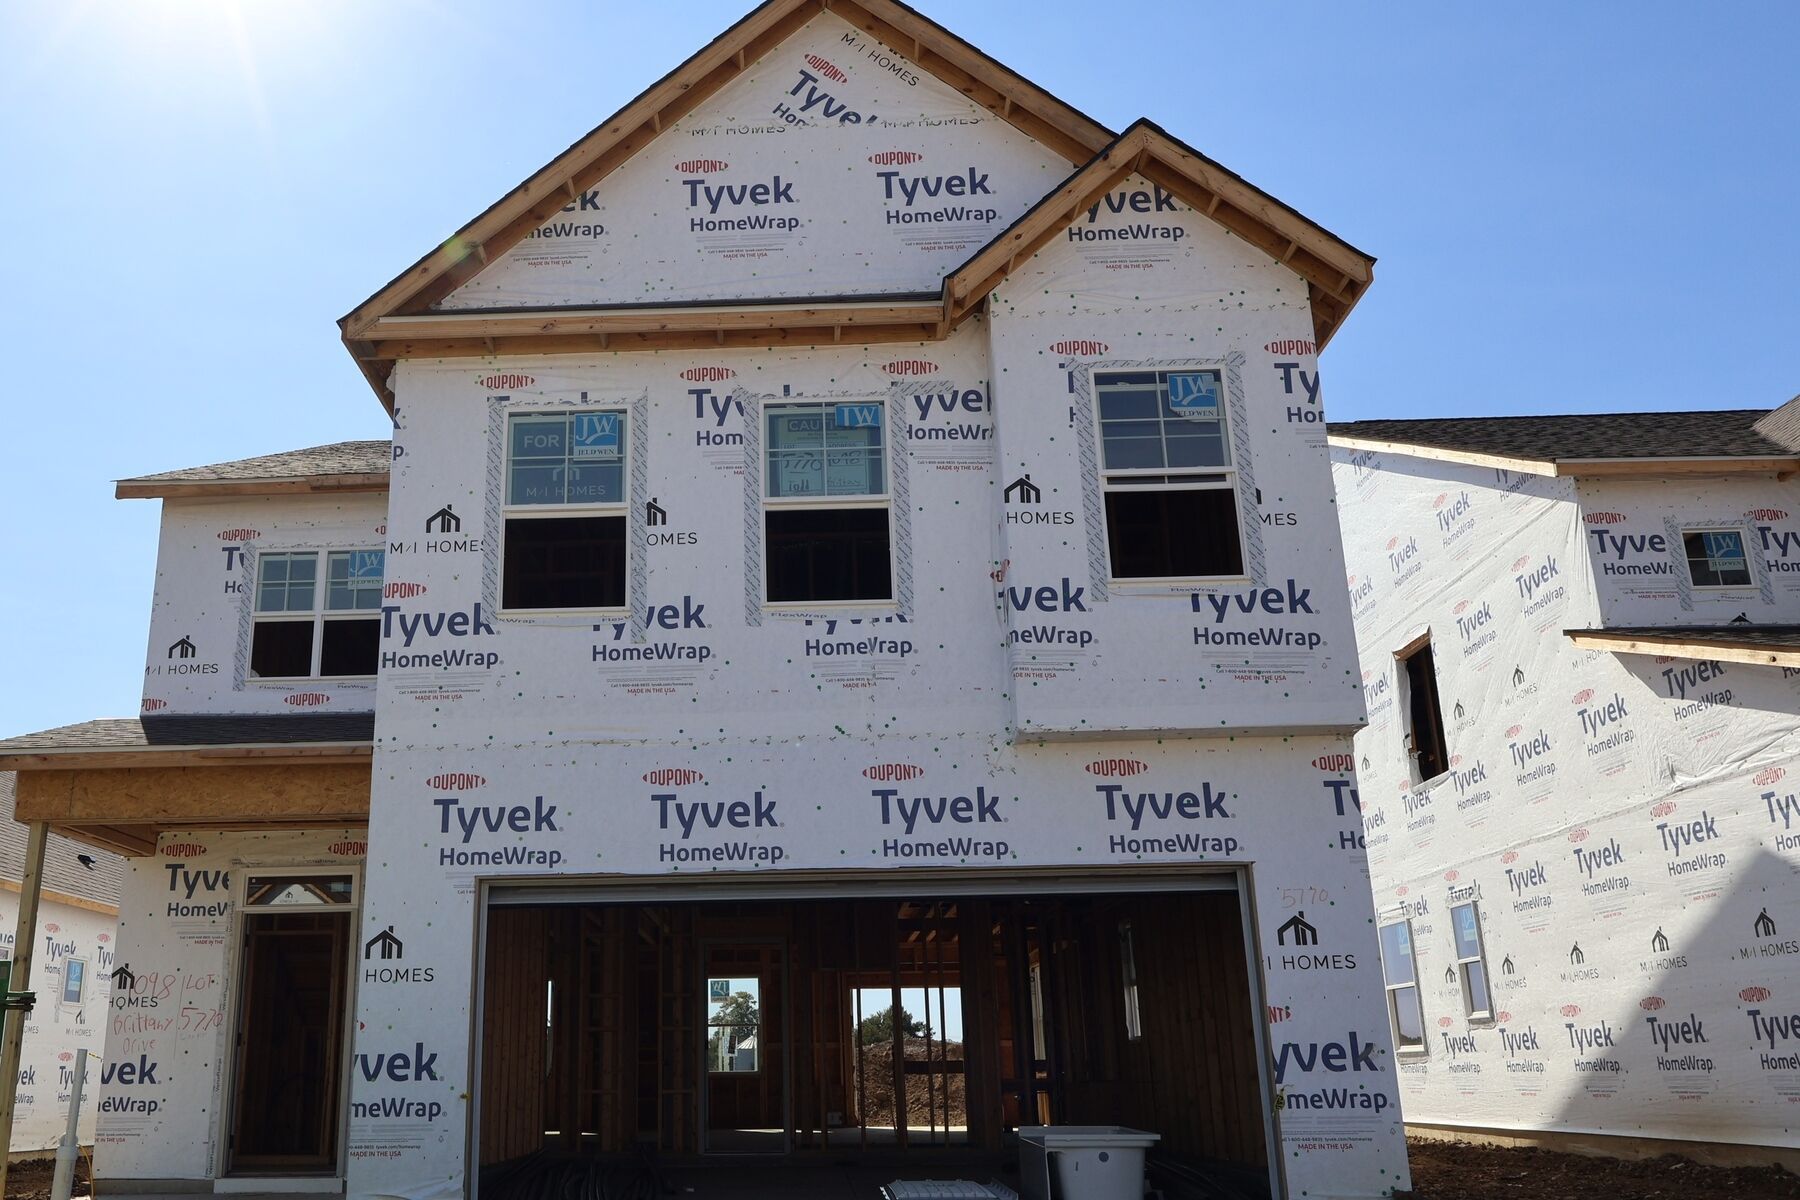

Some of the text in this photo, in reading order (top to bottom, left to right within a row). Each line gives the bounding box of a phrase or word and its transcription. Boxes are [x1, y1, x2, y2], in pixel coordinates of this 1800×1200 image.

[808, 55, 844, 83] DUPONT
[867, 49, 920, 87] HOMES
[681, 160, 724, 173] DUPONT
[875, 151, 916, 165] DUPONT
[682, 176, 794, 214] Tyvek
[877, 167, 992, 206] Tyvek
[1088, 183, 1177, 223] yvek
[690, 215, 800, 232] HomeWrap
[886, 207, 997, 224] HomeWrap
[525, 223, 605, 239] meWrap
[1069, 224, 1185, 242] HomeWrap
[1057, 341, 1103, 356] DUPONT
[687, 367, 729, 382] DUPONT
[889, 361, 932, 375] DUPONT
[487, 374, 529, 389] DUPONT
[575, 415, 617, 442] JW
[524, 434, 560, 448] FOR
[555, 485, 606, 497] HOMES
[1006, 511, 1075, 525] HOMES
[1261, 512, 1298, 526] MES
[1436, 490, 1470, 532] Tyvek
[1587, 512, 1622, 524] DUPONT
[222, 529, 257, 541] DUPONT
[646, 532, 698, 546] OMES
[1442, 517, 1474, 549] HomeWrap
[1389, 536, 1417, 574] Tyvek
[1591, 529, 1666, 560] Tyve
[1394, 561, 1421, 589] HomeWrap
[1515, 554, 1559, 600] Tyvek
[384, 583, 421, 598] UPONT
[1008, 578, 1087, 613] vek
[1523, 585, 1564, 619] HomeWrap
[381, 602, 496, 647] Tyvek
[1456, 601, 1492, 641] Tyvek
[1194, 627, 1321, 649] HomeWrap
[1463, 629, 1497, 658] HomeWrap
[382, 649, 499, 669] HomeWrap
[592, 643, 711, 662] HomeWrap
[168, 664, 219, 675] HOMES
[1662, 660, 1725, 700] Tyvek
[1363, 672, 1390, 705] Tyvek
[289, 693, 325, 706] DUPONT
[1674, 688, 1732, 721] HomeWrap
[1577, 692, 1628, 738] Tyvek
[1509, 729, 1550, 769] Tyvek
[1587, 729, 1634, 757] HomeWrap
[650, 769, 696, 786] DUPONT
[869, 763, 918, 781] DUPONT
[1093, 760, 1143, 777] DUPONT
[1450, 760, 1487, 796] Tyvek
[1516, 762, 1556, 786] HomeWrap
[1755, 768, 1783, 786] DUPONT
[434, 773, 480, 790] DUPONT
[872, 787, 1002, 834] Tyvek
[1096, 782, 1230, 829] Tyvek
[1457, 790, 1491, 811] HomeWrap
[434, 796, 557, 843] Tyvek
[651, 792, 779, 839] Tyvek
[1407, 814, 1435, 832] HomeWrap
[1656, 810, 1718, 857] Tyvek
[166, 844, 202, 858] DUPONT
[659, 842, 784, 864] HomeWrap
[883, 836, 1009, 858] HomeWrap
[1110, 833, 1238, 856] HomeWrap
[439, 847, 562, 868] HomeWrap
[1573, 838, 1623, 879] Tyvek
[1667, 853, 1726, 876] HomeWrap
[1505, 860, 1546, 896] Tyvek
[1583, 876, 1629, 896] HomeWrap
[1282, 888, 1329, 908] 5770
[1513, 894, 1551, 913] HomeWrap
[1761, 941, 1799, 956] HOMES
[1283, 954, 1357, 970] HOMES
[1657, 956, 1688, 970] HOMES
[186, 974, 214, 990] LOT
[365, 967, 435, 983] HOMES
[1504, 977, 1527, 989] HOMES
[1574, 968, 1599, 981] HOMES
[1742, 987, 1769, 1002] DUPONT
[180, 1007, 224, 1031] 5770
[1499, 1026, 1539, 1057] Tyvek
[1566, 1020, 1614, 1055] Tyvek
[1646, 1013, 1707, 1052] Tyvek
[1441, 1030, 1477, 1059] Tyvek
[360, 1043, 438, 1081] vek
[1273, 1031, 1379, 1084] yvek
[1449, 1060, 1481, 1075] HomeWrap
[1506, 1059, 1545, 1074] HomeWrap
[1574, 1058, 1620, 1074] HomeWrap
[1657, 1055, 1713, 1073] HomeWrap
[352, 1098, 442, 1121] meWrap
[1287, 1088, 1388, 1113] meWrap
